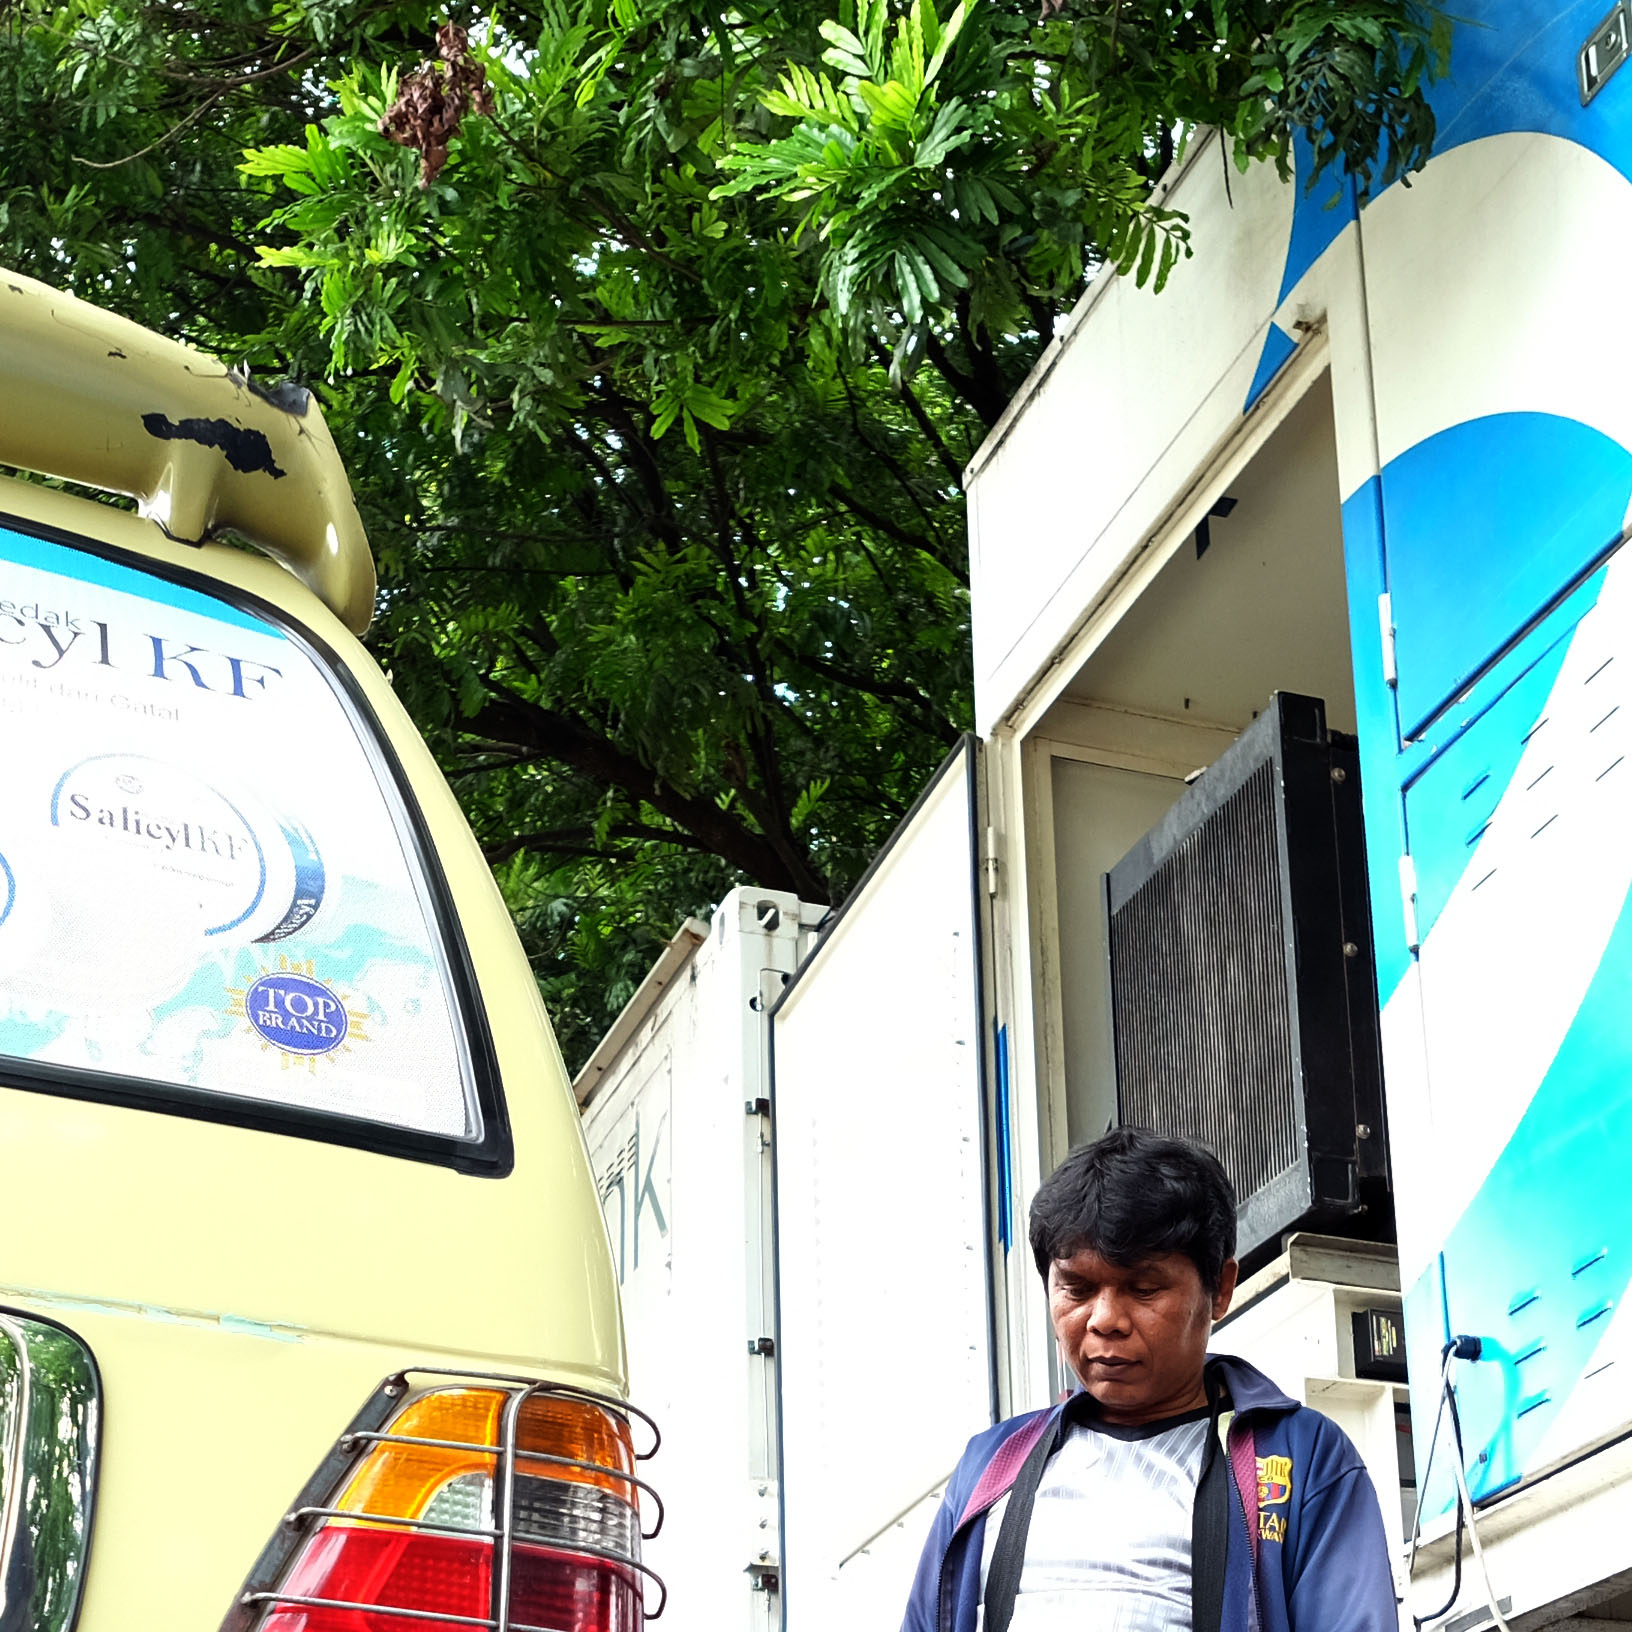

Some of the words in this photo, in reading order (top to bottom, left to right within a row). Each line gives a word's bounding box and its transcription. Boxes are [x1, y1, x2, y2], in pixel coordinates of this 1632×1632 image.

[142, 631, 285, 703] KF
[109, 691, 182, 723] Gatal
[256, 985, 338, 1021] TOP
[256, 1010, 339, 1040] BRAND
